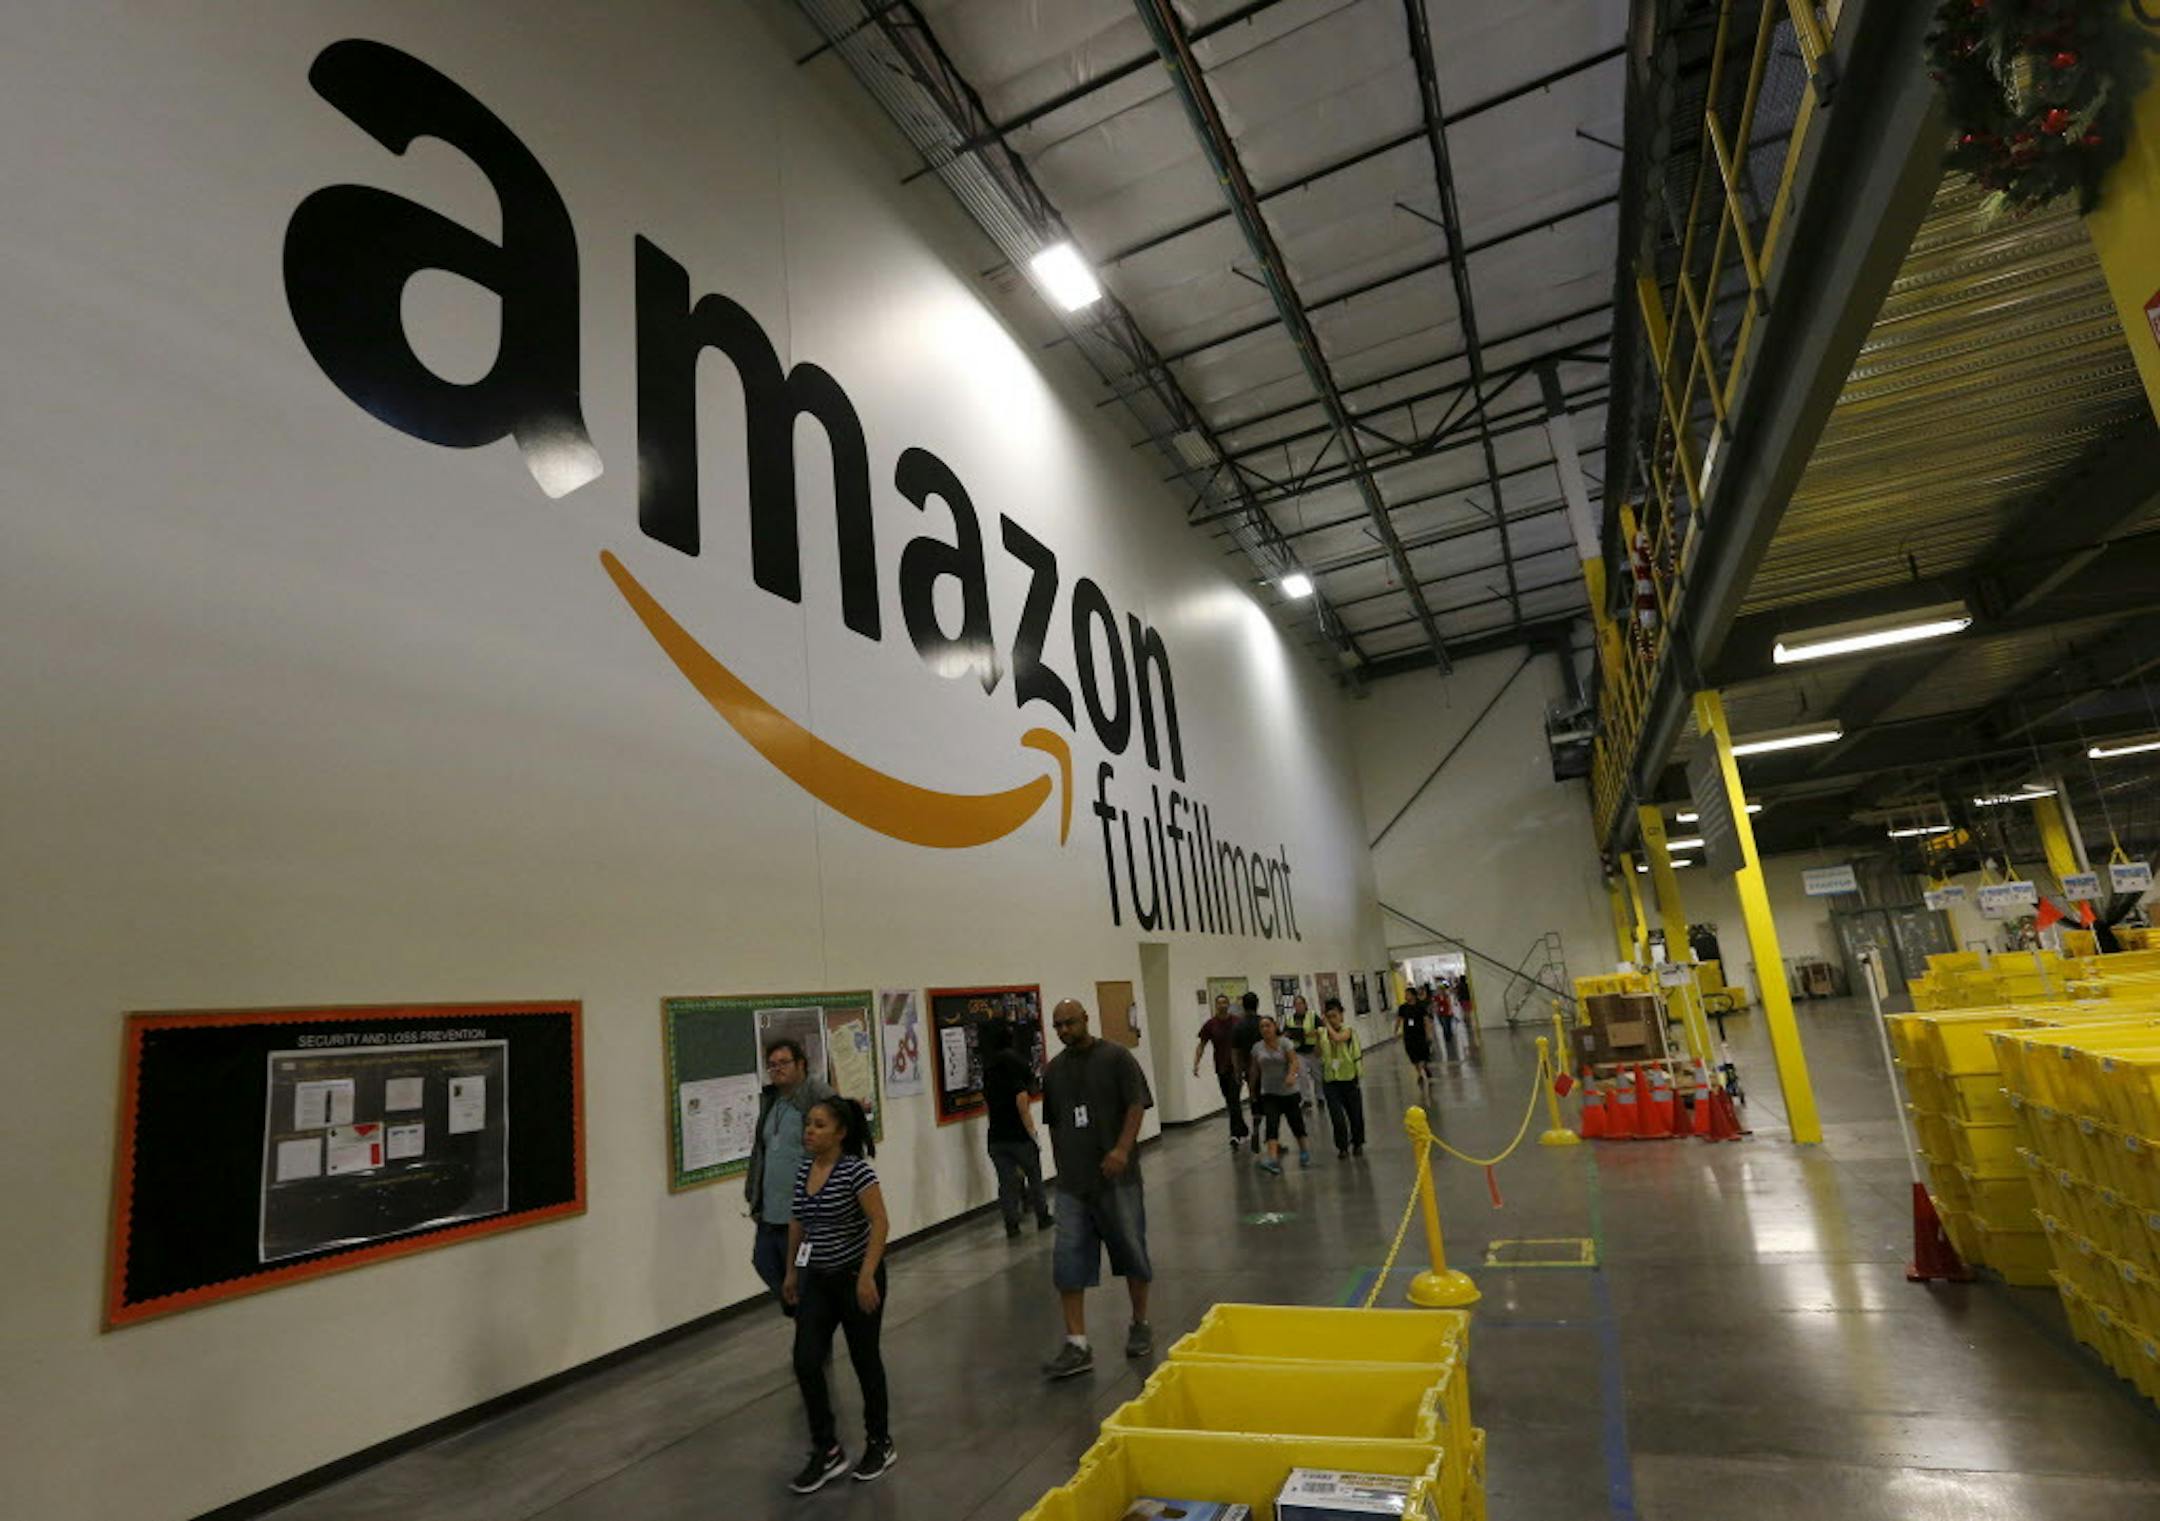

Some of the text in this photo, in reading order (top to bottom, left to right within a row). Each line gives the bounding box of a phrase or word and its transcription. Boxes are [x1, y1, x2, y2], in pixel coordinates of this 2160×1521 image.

[283, 38, 1186, 783] amazon
[1092, 762, 1302, 941] fulfillment
[297, 1028, 486, 1048] SECURITY AND LOSS PREVENTION
